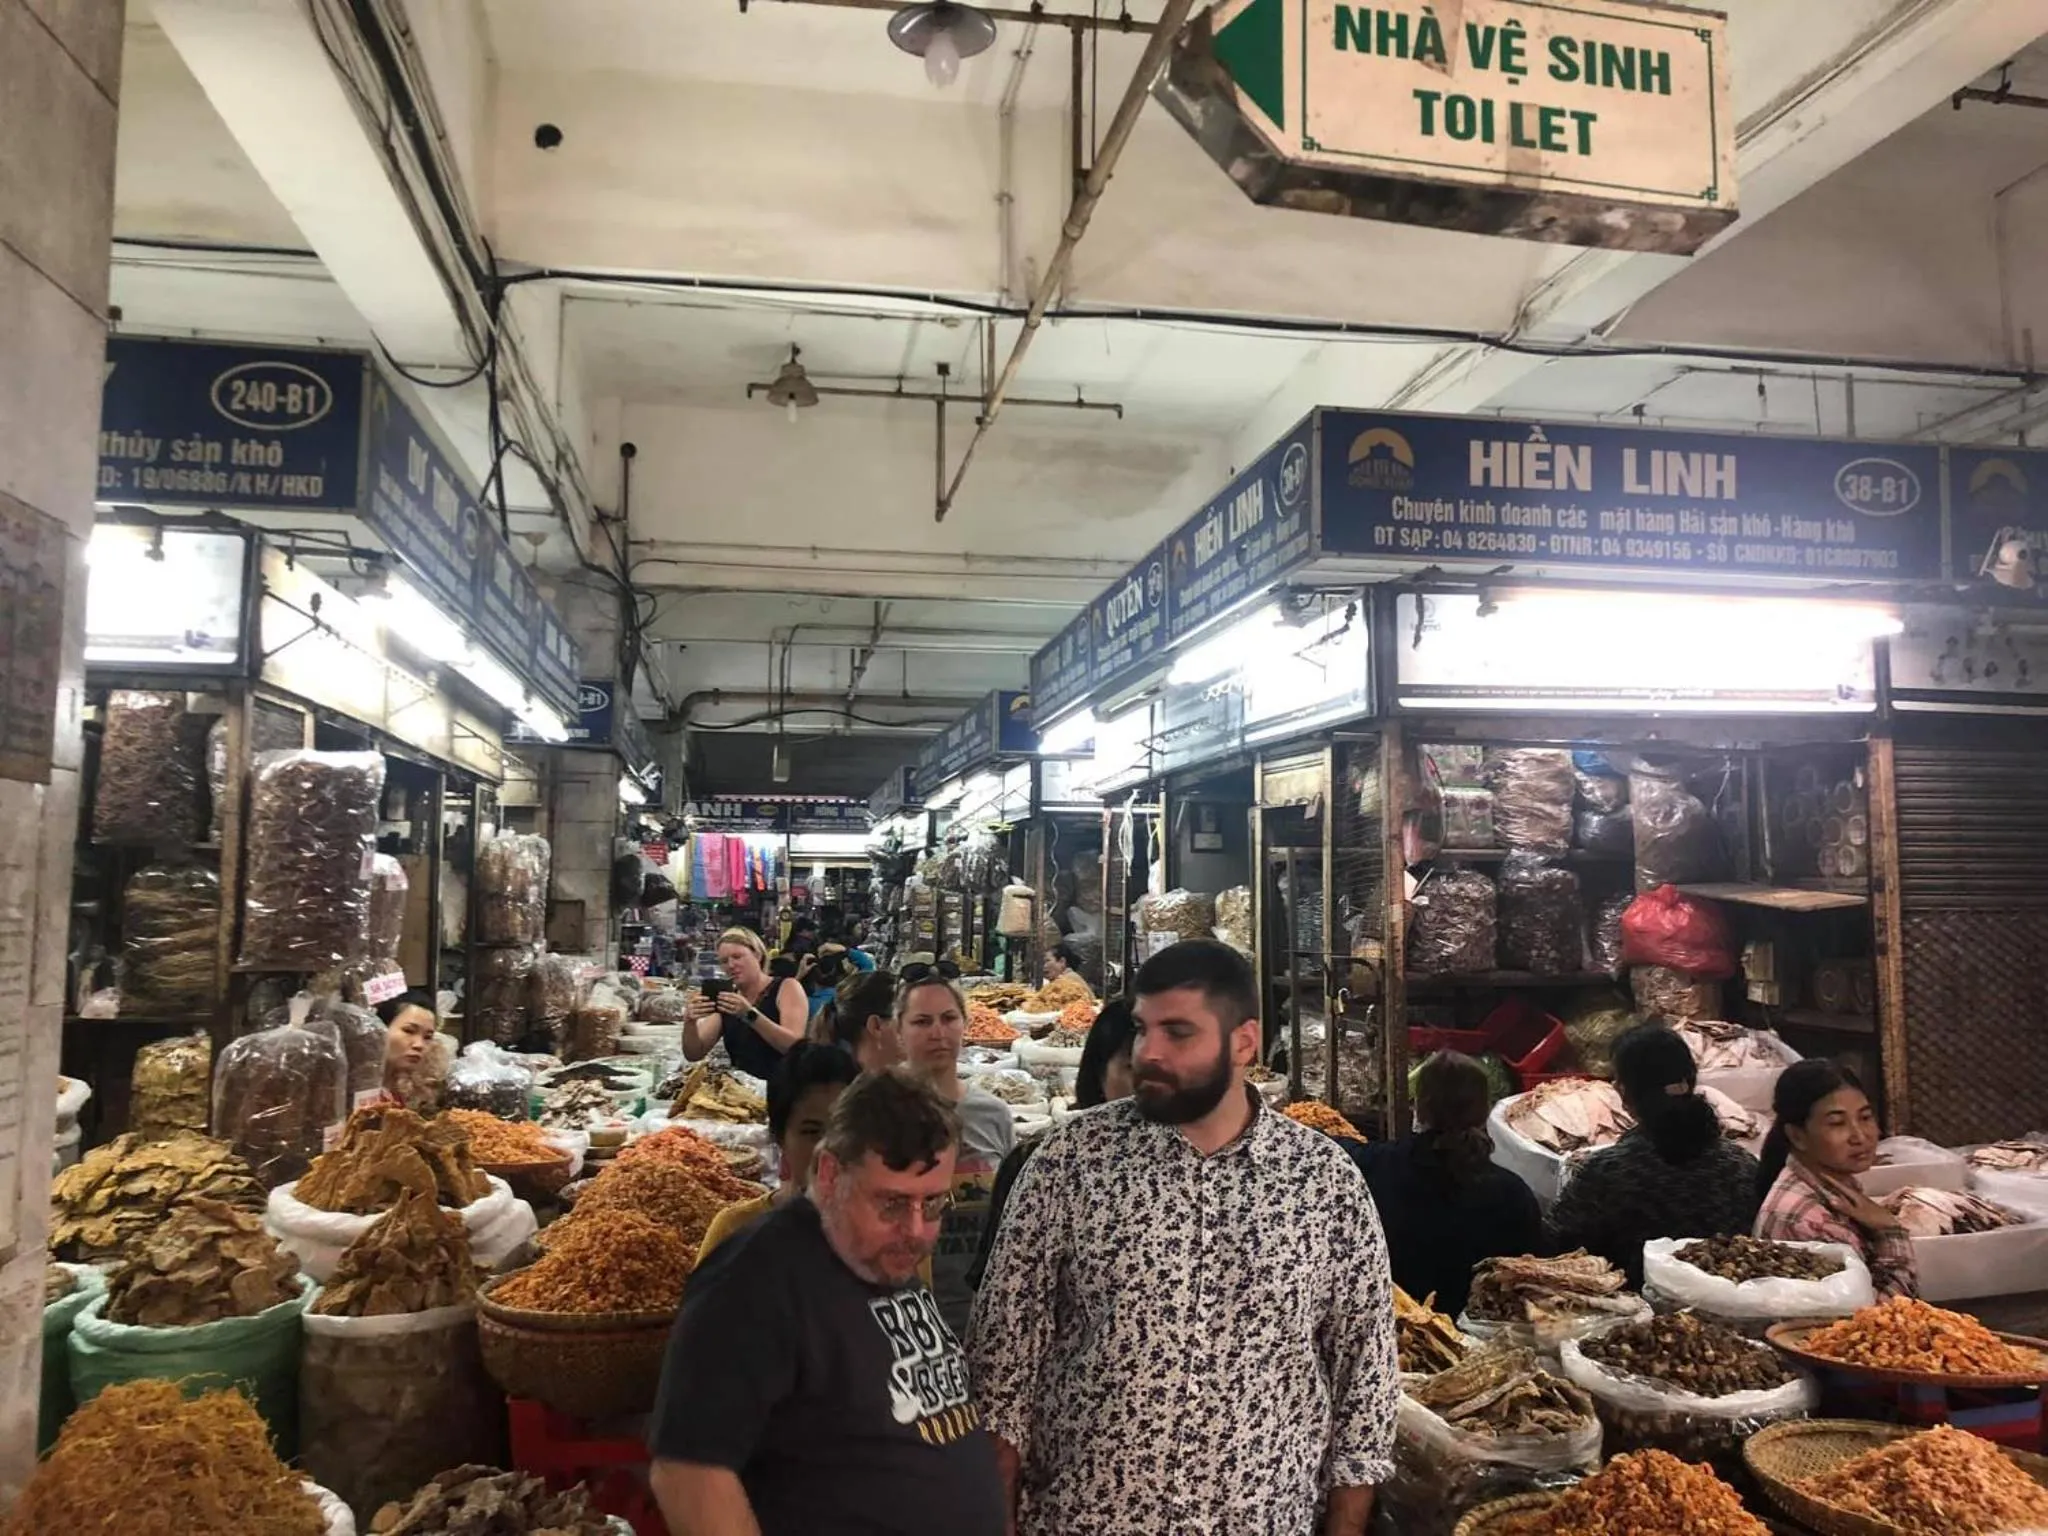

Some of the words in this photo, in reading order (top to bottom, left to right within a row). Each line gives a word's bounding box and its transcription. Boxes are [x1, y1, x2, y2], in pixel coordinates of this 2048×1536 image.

[1334, 3, 1448, 66] NHÀ
[1466, 19, 1528, 85] VỆ
[1548, 36, 1671, 96] SINH
[230, 379, 316, 415] 240-B1
[170, 433, 223, 464] sản
[231, 437, 283, 468] khô
[1469, 425, 1592, 491] HIỀN
[1622, 448, 1737, 500] LINH
[1844, 474, 1909, 505] 38-B1
[1229, 478, 1264, 542] LINH
[1392, 496, 1454, 525] Chuyên
[1459, 500, 1496, 526] kinh
[1501, 502, 1551, 528] doanh
[1557, 504, 1588, 529] các
[1636, 508, 1674, 536] hàng
[1680, 509, 1705, 535] Hải
[1710, 510, 1738, 536] sản
[1442, 531, 1463, 549] 04
[1602, 538, 1621, 556] 04
